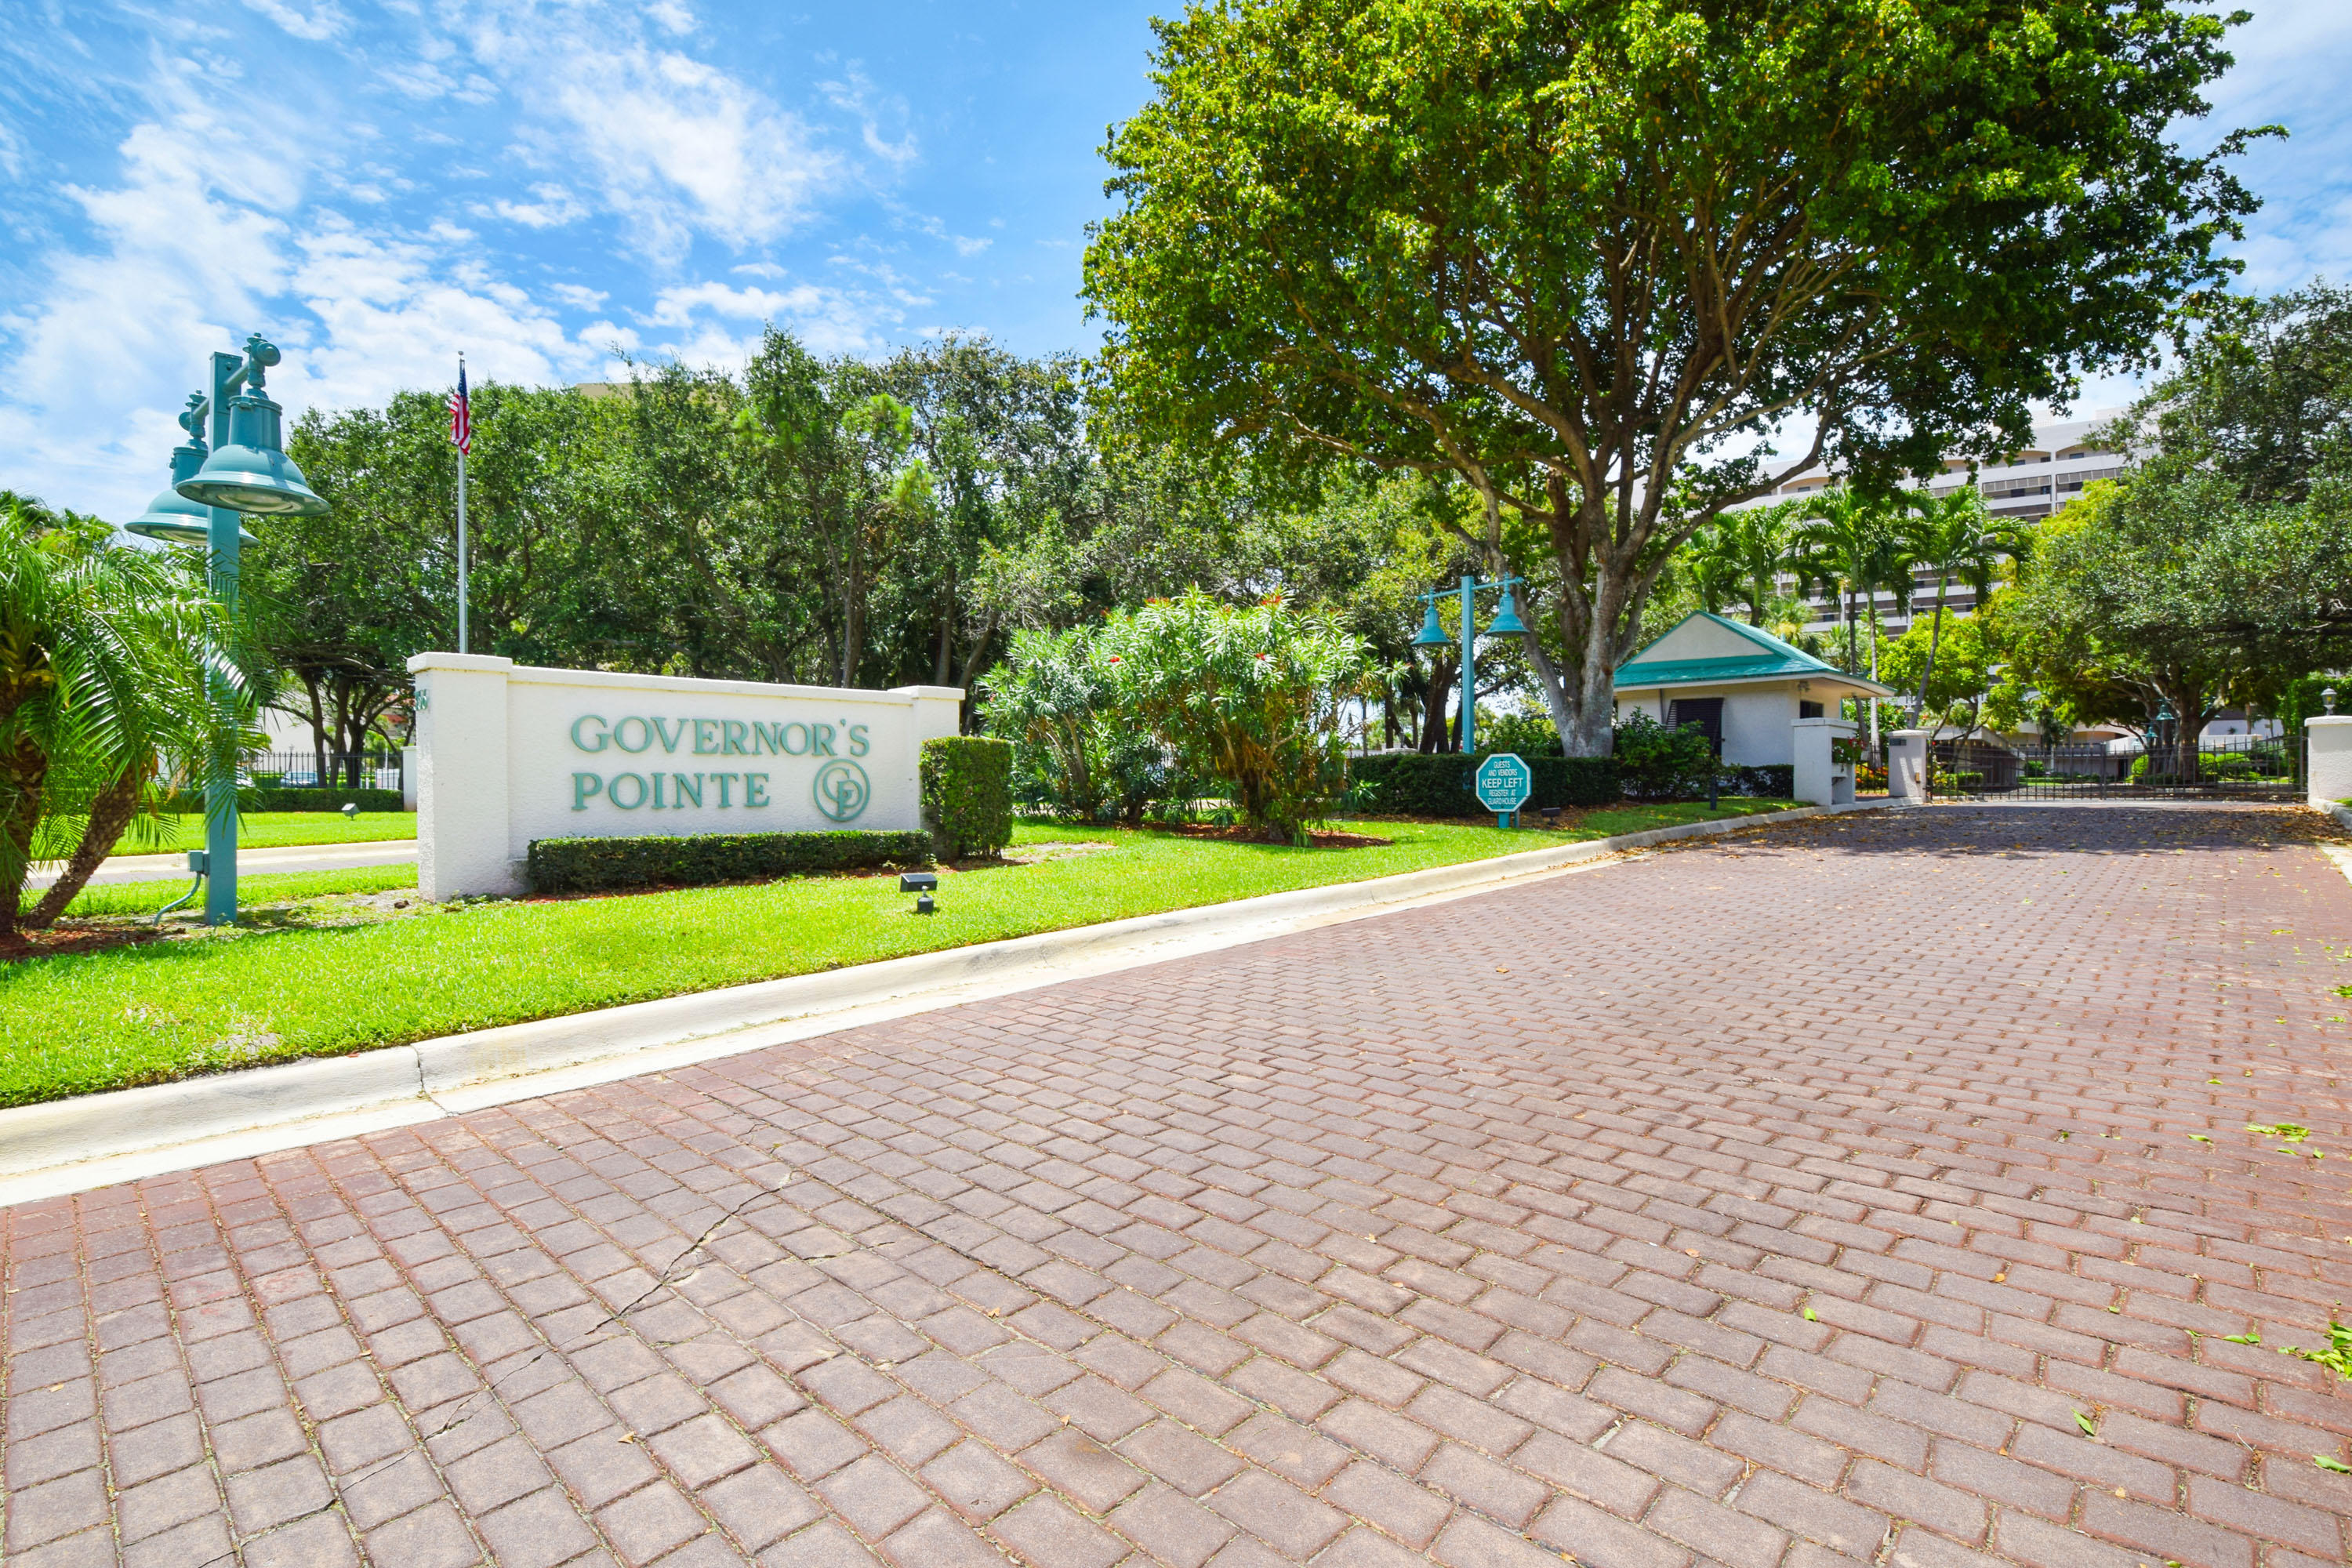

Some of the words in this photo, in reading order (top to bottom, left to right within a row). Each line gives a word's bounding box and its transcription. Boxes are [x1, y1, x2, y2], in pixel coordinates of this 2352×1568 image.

[571, 714, 870, 757] GOVERNOR'S
[571, 772, 771, 811] POINTE
[1482, 779, 1502, 789] KEEP
[1504, 778, 1523, 788] LEFT
